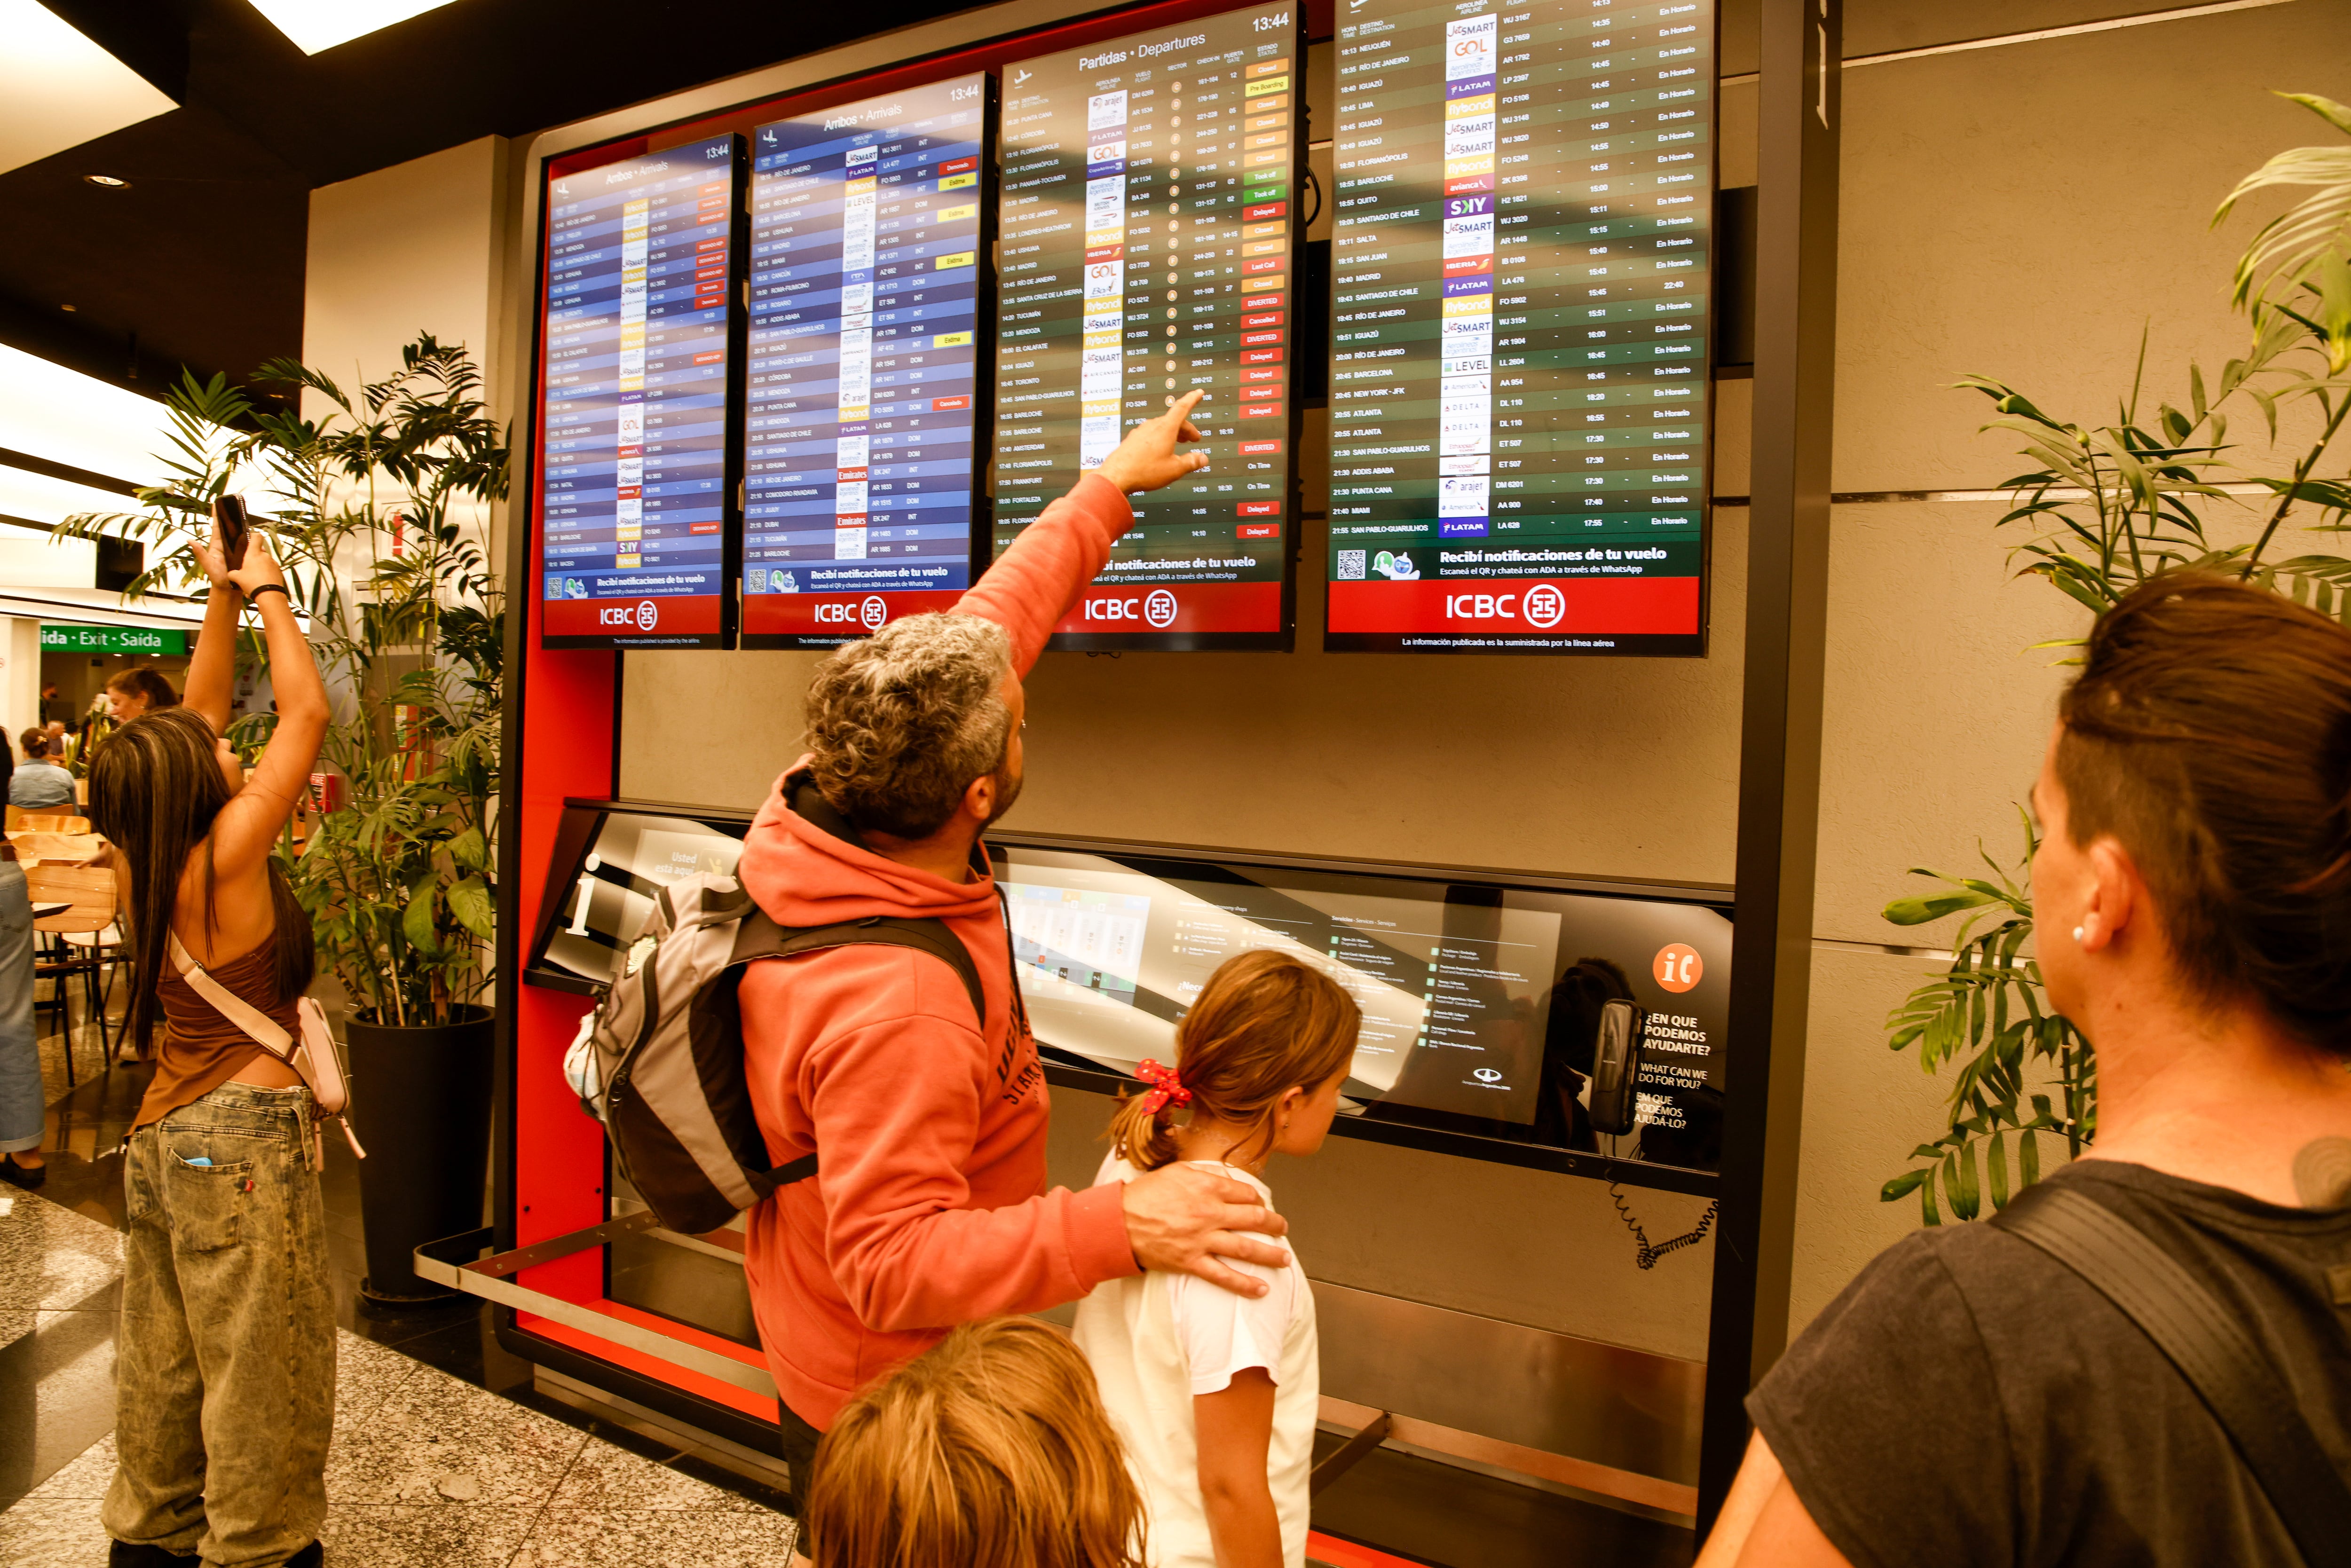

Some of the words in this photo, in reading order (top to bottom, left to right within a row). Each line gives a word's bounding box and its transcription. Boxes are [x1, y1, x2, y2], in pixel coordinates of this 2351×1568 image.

[1252, 11, 1289, 32] 13:44
[1341, 65, 1357, 74] 18:35
[1359, 63, 1372, 71] RÍO
[1381, 55, 1410, 67] JANEIRO
[1455, 38, 1488, 56] GOL
[1514, 33, 1530, 42] 7659
[1592, 18, 1610, 27] 14:35
[1670, 3, 1696, 14] Horario
[1079, 51, 1127, 71] Partidas
[1137, 34, 1206, 57] Departures
[1341, 47, 1357, 55] 18:13
[1359, 40, 1391, 52] NEUQUÉN
[1257, 64, 1277, 73] Closed
[950, 84, 979, 102] 13:44
[1260, 81, 1284, 90] Boarding
[1340, 104, 1356, 112] 18:45
[1358, 101, 1374, 110] LIMA
[1458, 80, 1491, 92] LATAM
[823, 115, 858, 132] Arribos
[865, 103, 902, 122] Arrivals
[1358, 118, 1382, 128] IGUAZÚ
[1448, 97, 1493, 116] flybondi
[705, 143, 728, 159] 13:44
[1357, 152, 1408, 166] FLORIANÓPOLIS
[605, 168, 633, 184] Arribos
[639, 158, 669, 176] Arrivals
[1357, 173, 1394, 186] BARILOCHE
[1357, 196, 1378, 205] QUITO
[1450, 180, 1479, 192] avianca
[1357, 213, 1389, 224] SANTIAGO
[1400, 209, 1420, 218] CHILE
[1356, 235, 1377, 243] SALTA
[1087, 249, 1112, 258] IBERIA
[1356, 272, 1381, 281] MADRID
[1446, 260, 1477, 269] IBERIA
[1664, 281, 1684, 289] 22:40
[1247, 297, 1278, 307] DIVERTED
[1248, 315, 1276, 324] Cancelled
[1250, 352, 1273, 361] Delayed
[1354, 369, 1393, 378] BARCELONA
[1456, 360, 1489, 371] LEVEL
[1353, 409, 1382, 417] ATLANTA
[838, 470, 867, 480] Emirates
[1460, 481, 1483, 493] arajet
[1439, 550, 1483, 563] Recibí
[1484, 549, 1584, 562] notificaciones
[1584, 548, 1604, 560] de
[1605, 549, 1623, 560] tu
[1623, 547, 1667, 559] vuelo
[1114, 558, 1191, 570] notificaciones
[1191, 557, 1207, 568] de
[1207, 558, 1221, 567] tu
[1221, 556, 1256, 567] vuelo
[1601, 565, 1642, 575] WhatsApp
[597, 577, 618, 586] Recibí
[618, 575, 665, 585] notificaciones
[665, 575, 675, 583] de
[684, 574, 705, 583] vuelo
[810, 569, 837, 579] Recibí
[837, 568, 897, 578] notificaciones
[897, 567, 909, 577] de
[909, 568, 921, 576] tu
[921, 566, 948, 576] vuelo
[814, 603, 857, 622] ICBC
[1084, 598, 1138, 620] ICBC
[1446, 594, 1515, 618] ICBC
[600, 607, 634, 625] ICBC
[41, 630, 67, 644] ida
[79, 631, 108, 646] Exit
[120, 633, 162, 646] Saída
[1452, 638, 1485, 647] publicada
[672, 851, 697, 864] Usted
[655, 864, 673, 874] está
[1646, 1012, 1669, 1025] ¿EN
[1671, 1014, 1697, 1028] QUE
[1644, 1025, 1706, 1042] PODEMOS
[1643, 1038, 1711, 1056] AYUDARTE?
[1640, 1062, 1669, 1076] WHAT
[1669, 1066, 1692, 1078] CAN
[1691, 1069, 1708, 1080] WE
[1638, 1072, 1654, 1084] DO
[1655, 1074, 1675, 1086] FOR
[1675, 1077, 1701, 1090] YOU?
[1636, 1092, 1652, 1102] EM
[1653, 1094, 1673, 1105] QUE
[1634, 1102, 1683, 1118] PODEMOS
[1633, 1115, 1687, 1129] AJUDÁ-LO?
